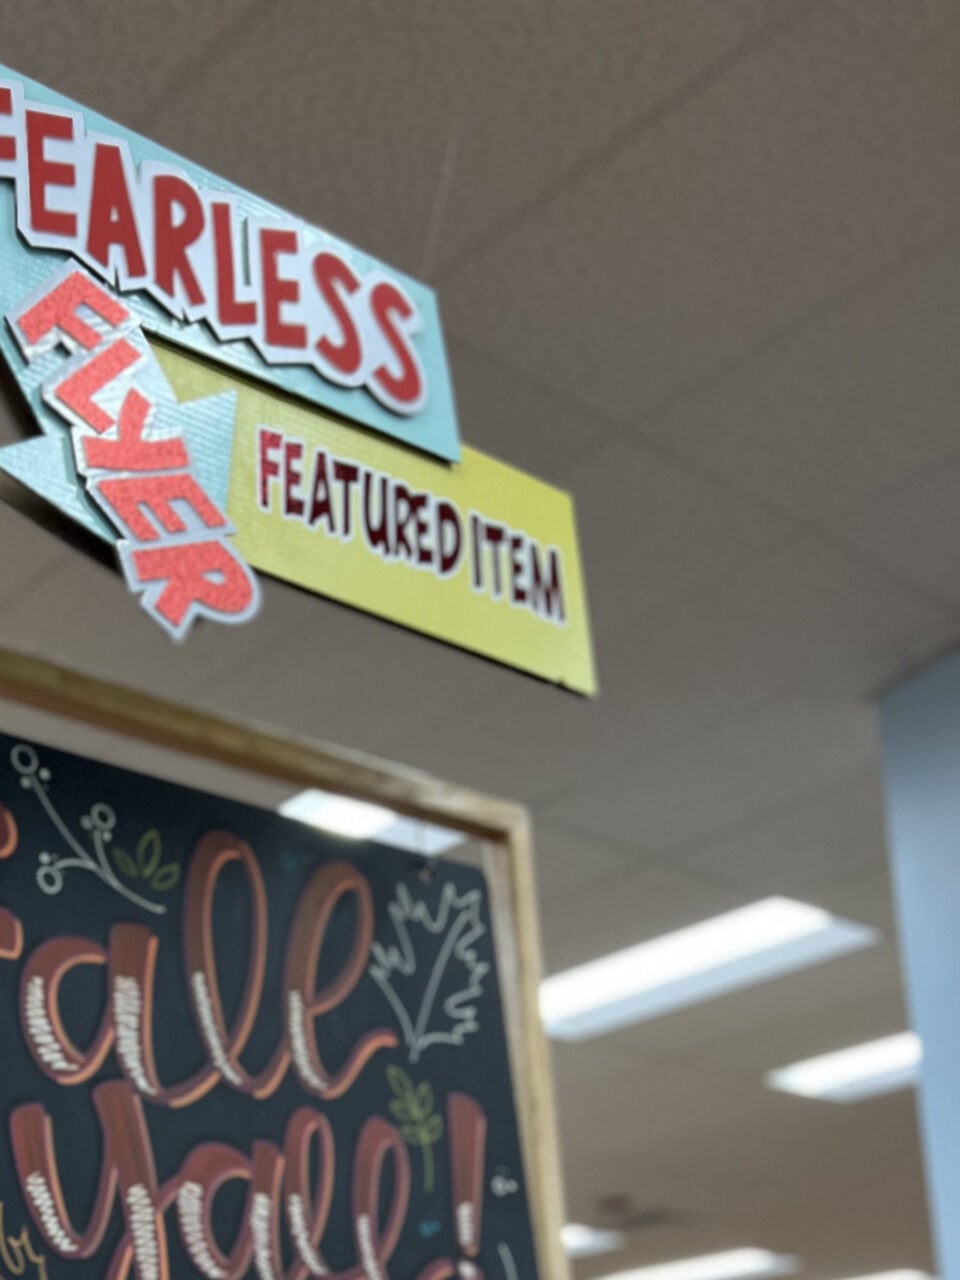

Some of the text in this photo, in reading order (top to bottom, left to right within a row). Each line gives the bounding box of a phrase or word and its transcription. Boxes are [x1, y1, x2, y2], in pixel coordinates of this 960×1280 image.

[16, 270, 257, 638] FLYER
[258, 430, 566, 622] FEATURED ITEM
